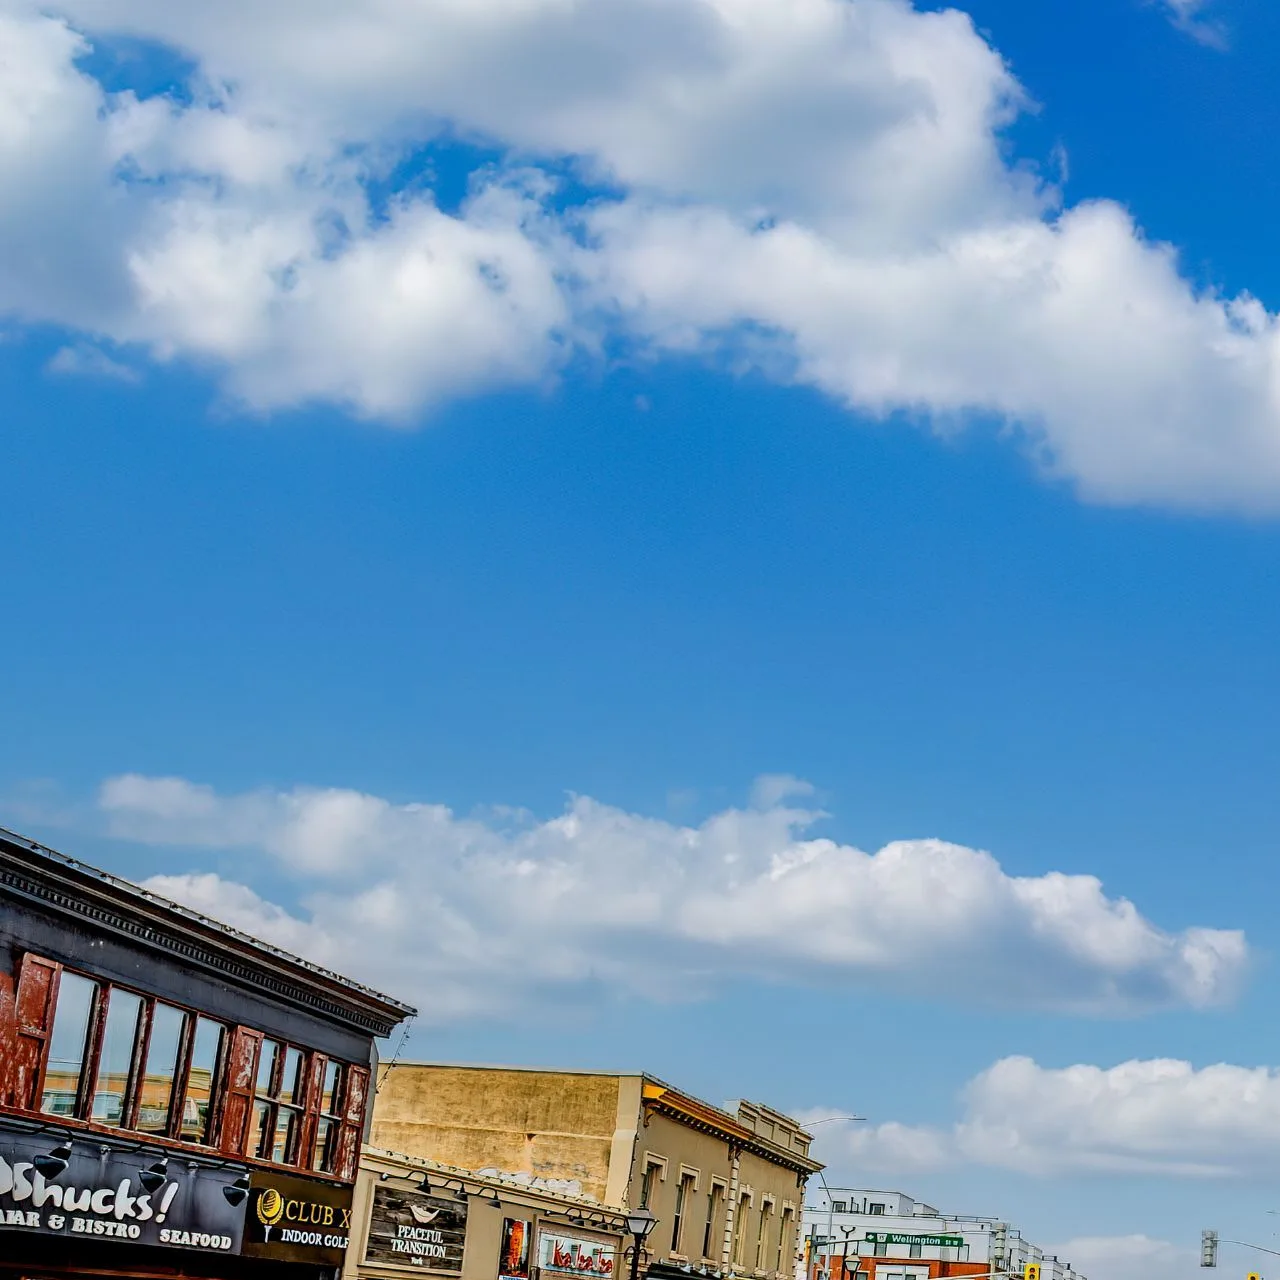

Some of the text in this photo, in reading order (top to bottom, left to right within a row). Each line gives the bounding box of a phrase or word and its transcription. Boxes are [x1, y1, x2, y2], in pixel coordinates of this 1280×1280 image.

[286, 1200, 353, 1229] CLUB X
[48, 1214, 66, 1230] &
[71, 1216, 141, 1240] BISTRO
[398, 1225, 444, 1243] PEACEFUL
[159, 1228, 232, 1250] SEAFOOD
[281, 1229, 350, 1249] INDOOR GOLF
[391, 1239, 447, 1258] TRANSITION
[891, 1234, 941, 1245] Wellington
